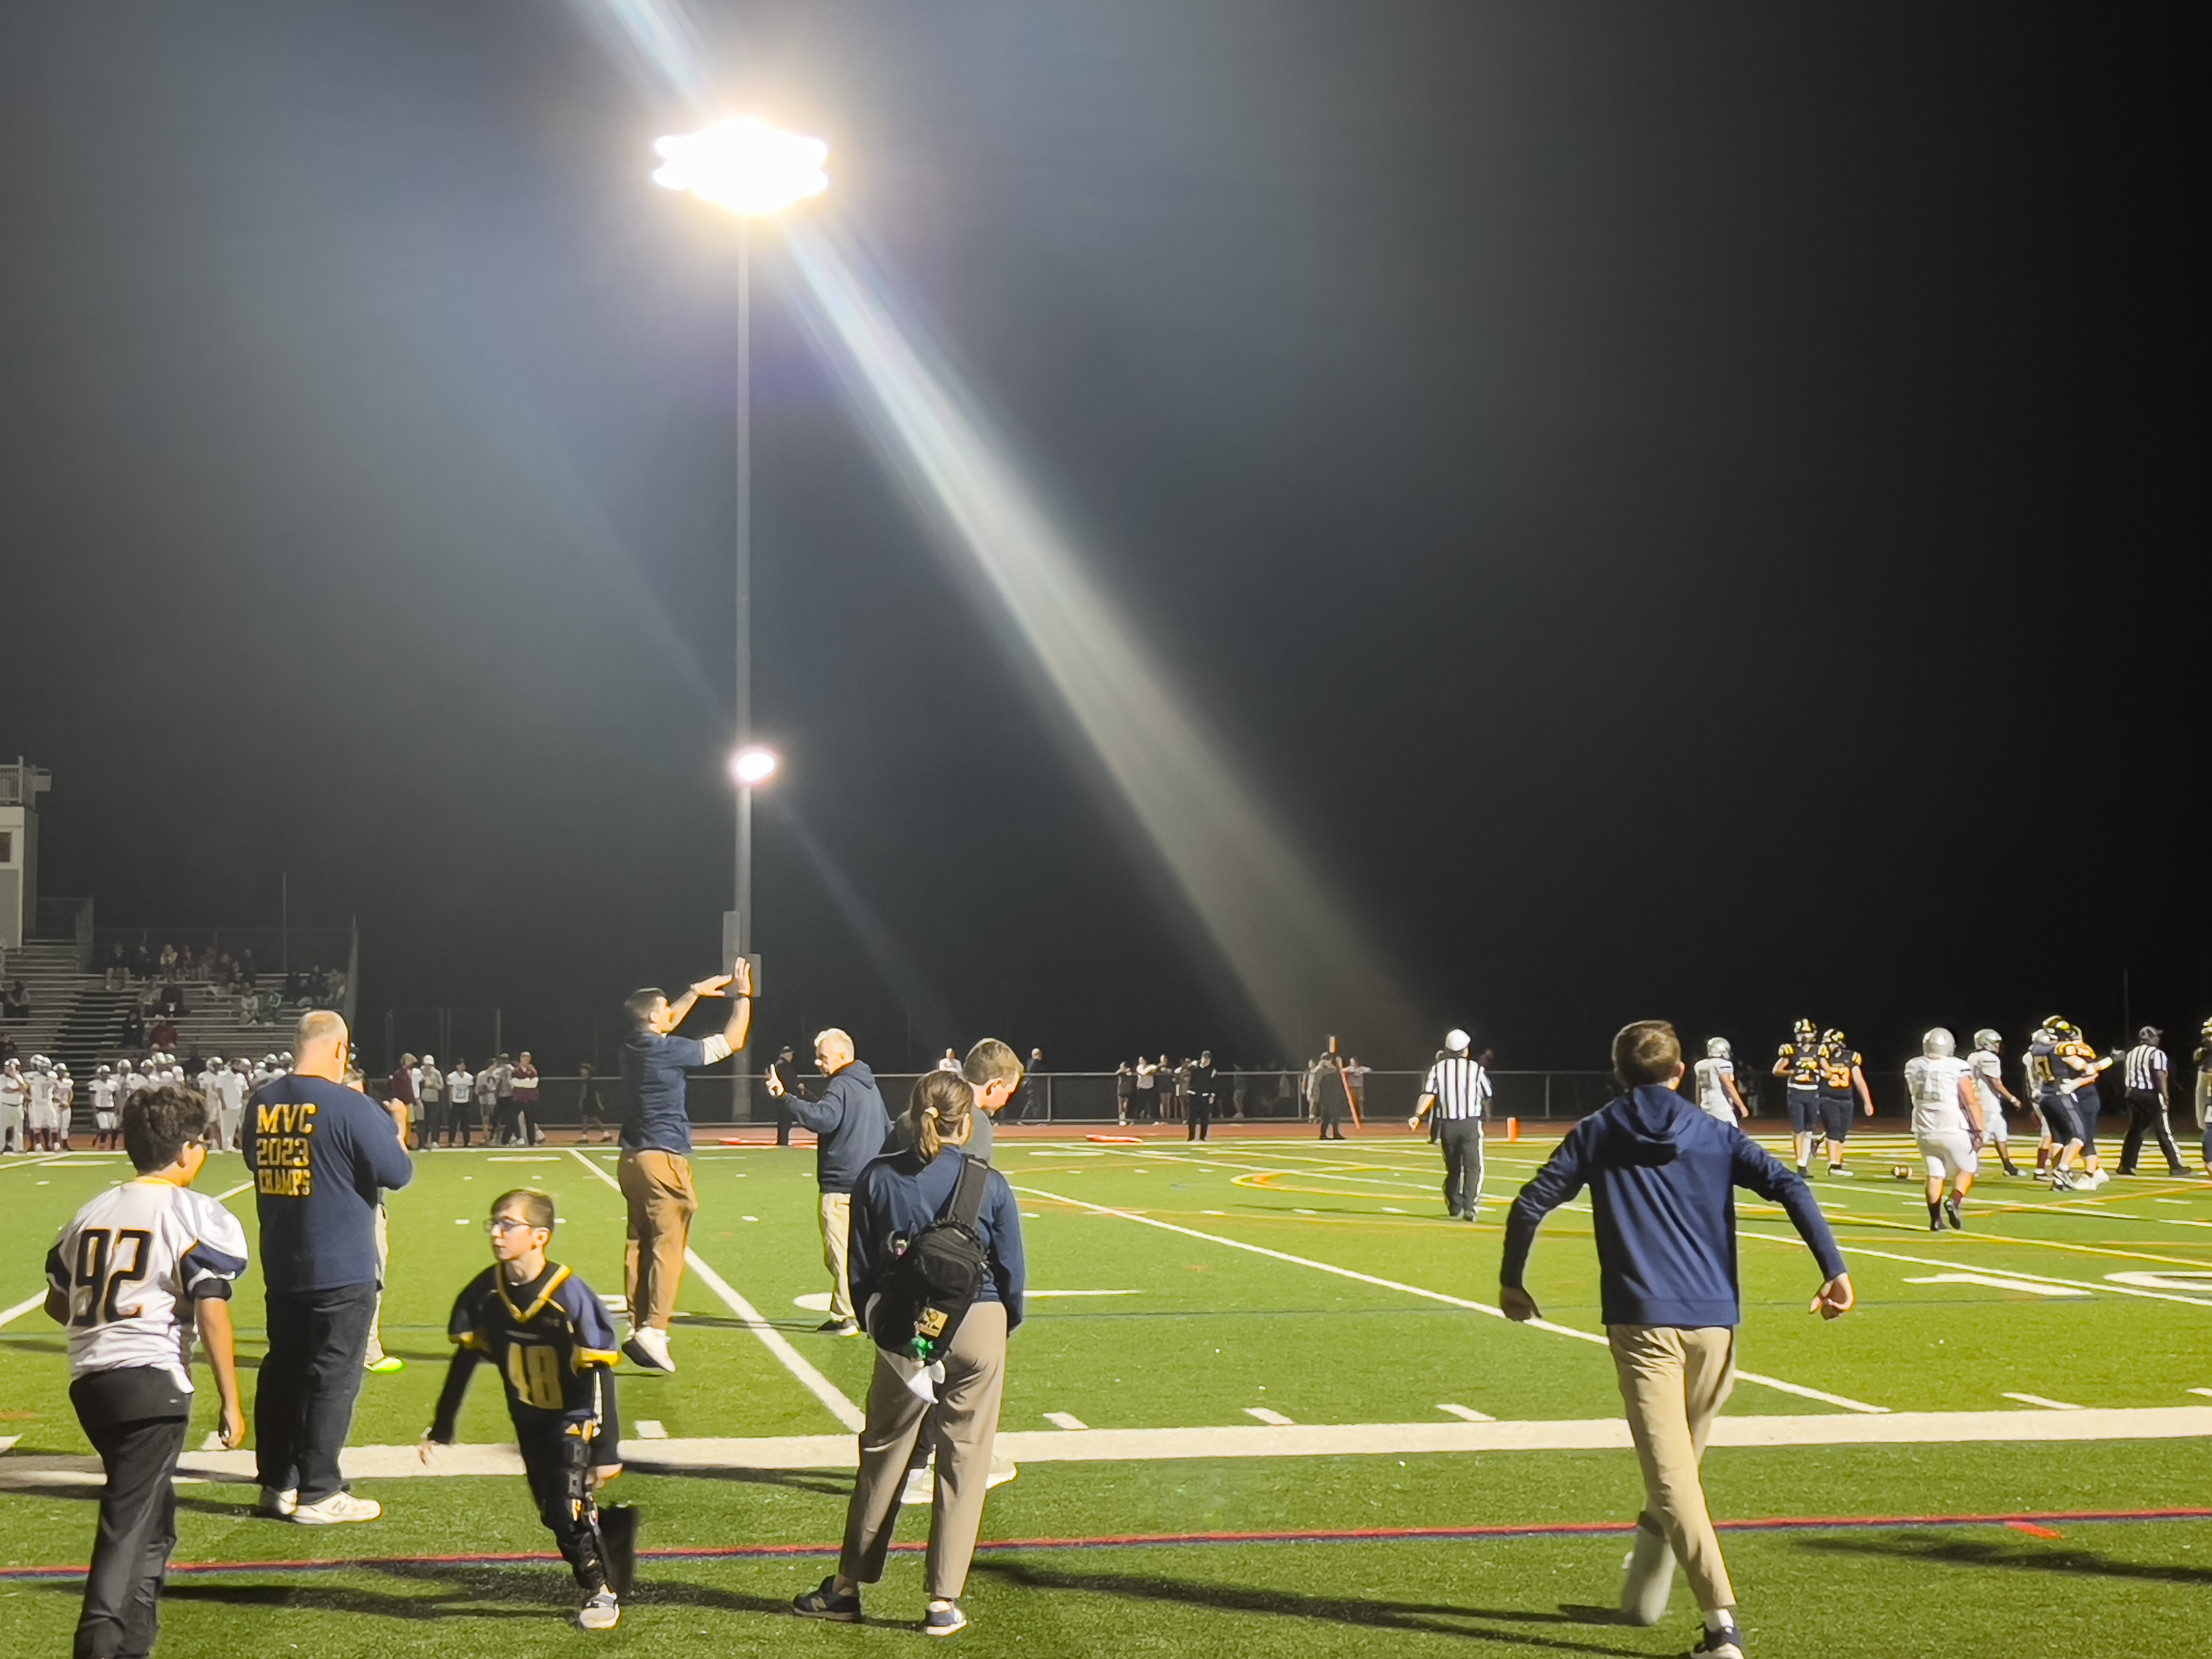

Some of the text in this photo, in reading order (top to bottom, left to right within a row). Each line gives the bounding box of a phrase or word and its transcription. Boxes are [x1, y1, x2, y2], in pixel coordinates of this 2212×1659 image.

[256, 1103, 316, 1134] MVC
[256, 1137, 310, 1167] 2023
[258, 1168, 311, 1196] CHAMPS
[70, 1229, 153, 1326] 92
